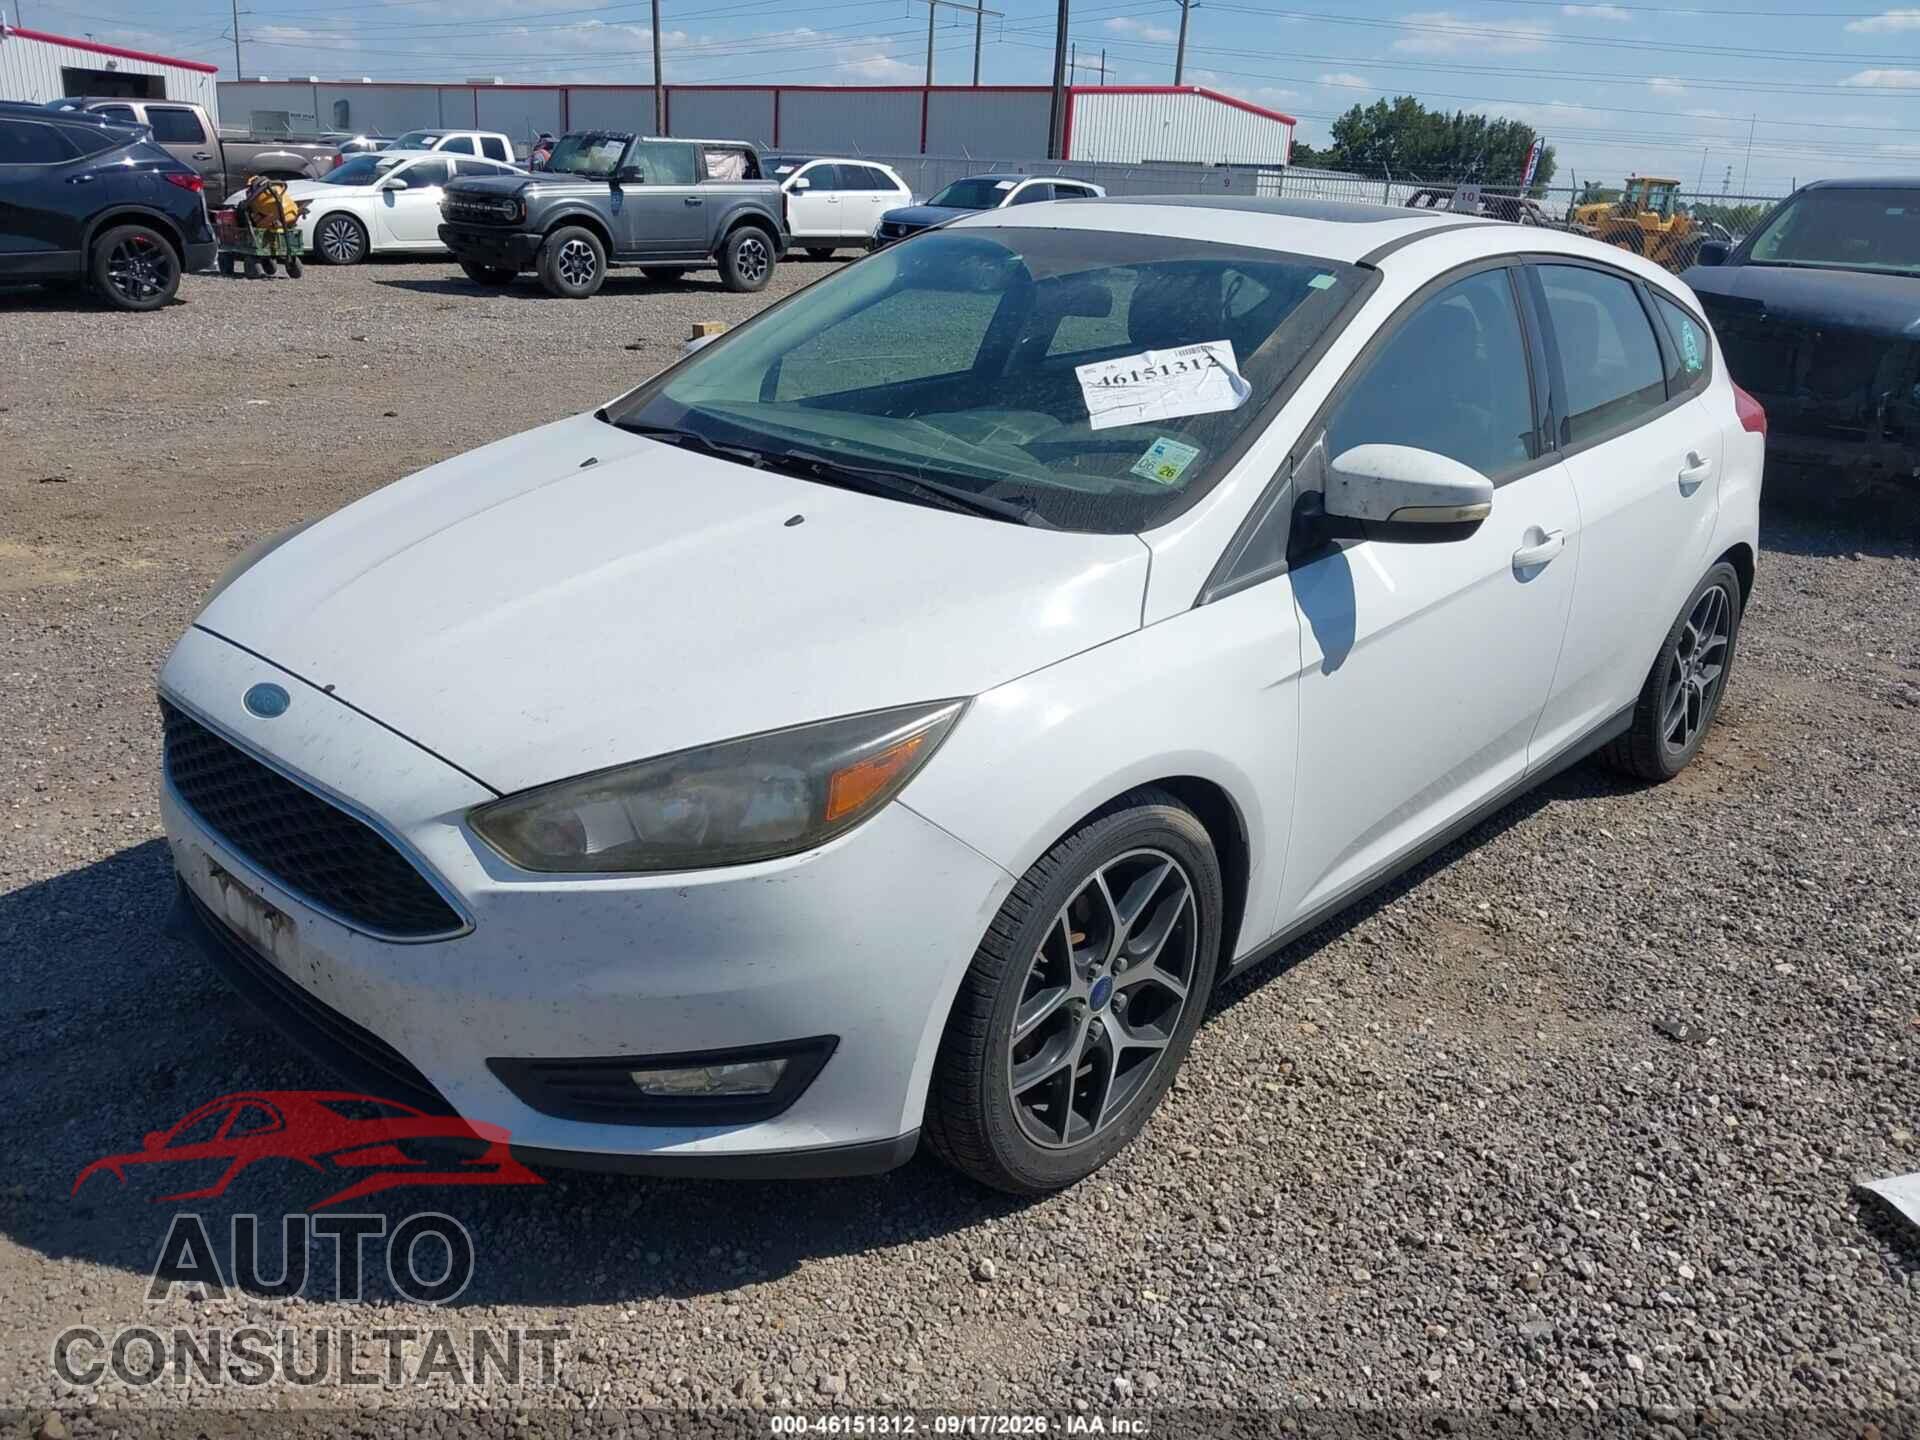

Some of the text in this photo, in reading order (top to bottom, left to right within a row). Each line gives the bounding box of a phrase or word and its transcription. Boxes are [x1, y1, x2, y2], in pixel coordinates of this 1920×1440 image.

[1461, 192, 1474, 201] 10
[1097, 355, 1221, 386] 46151312
[1159, 465, 1177, 478] 26
